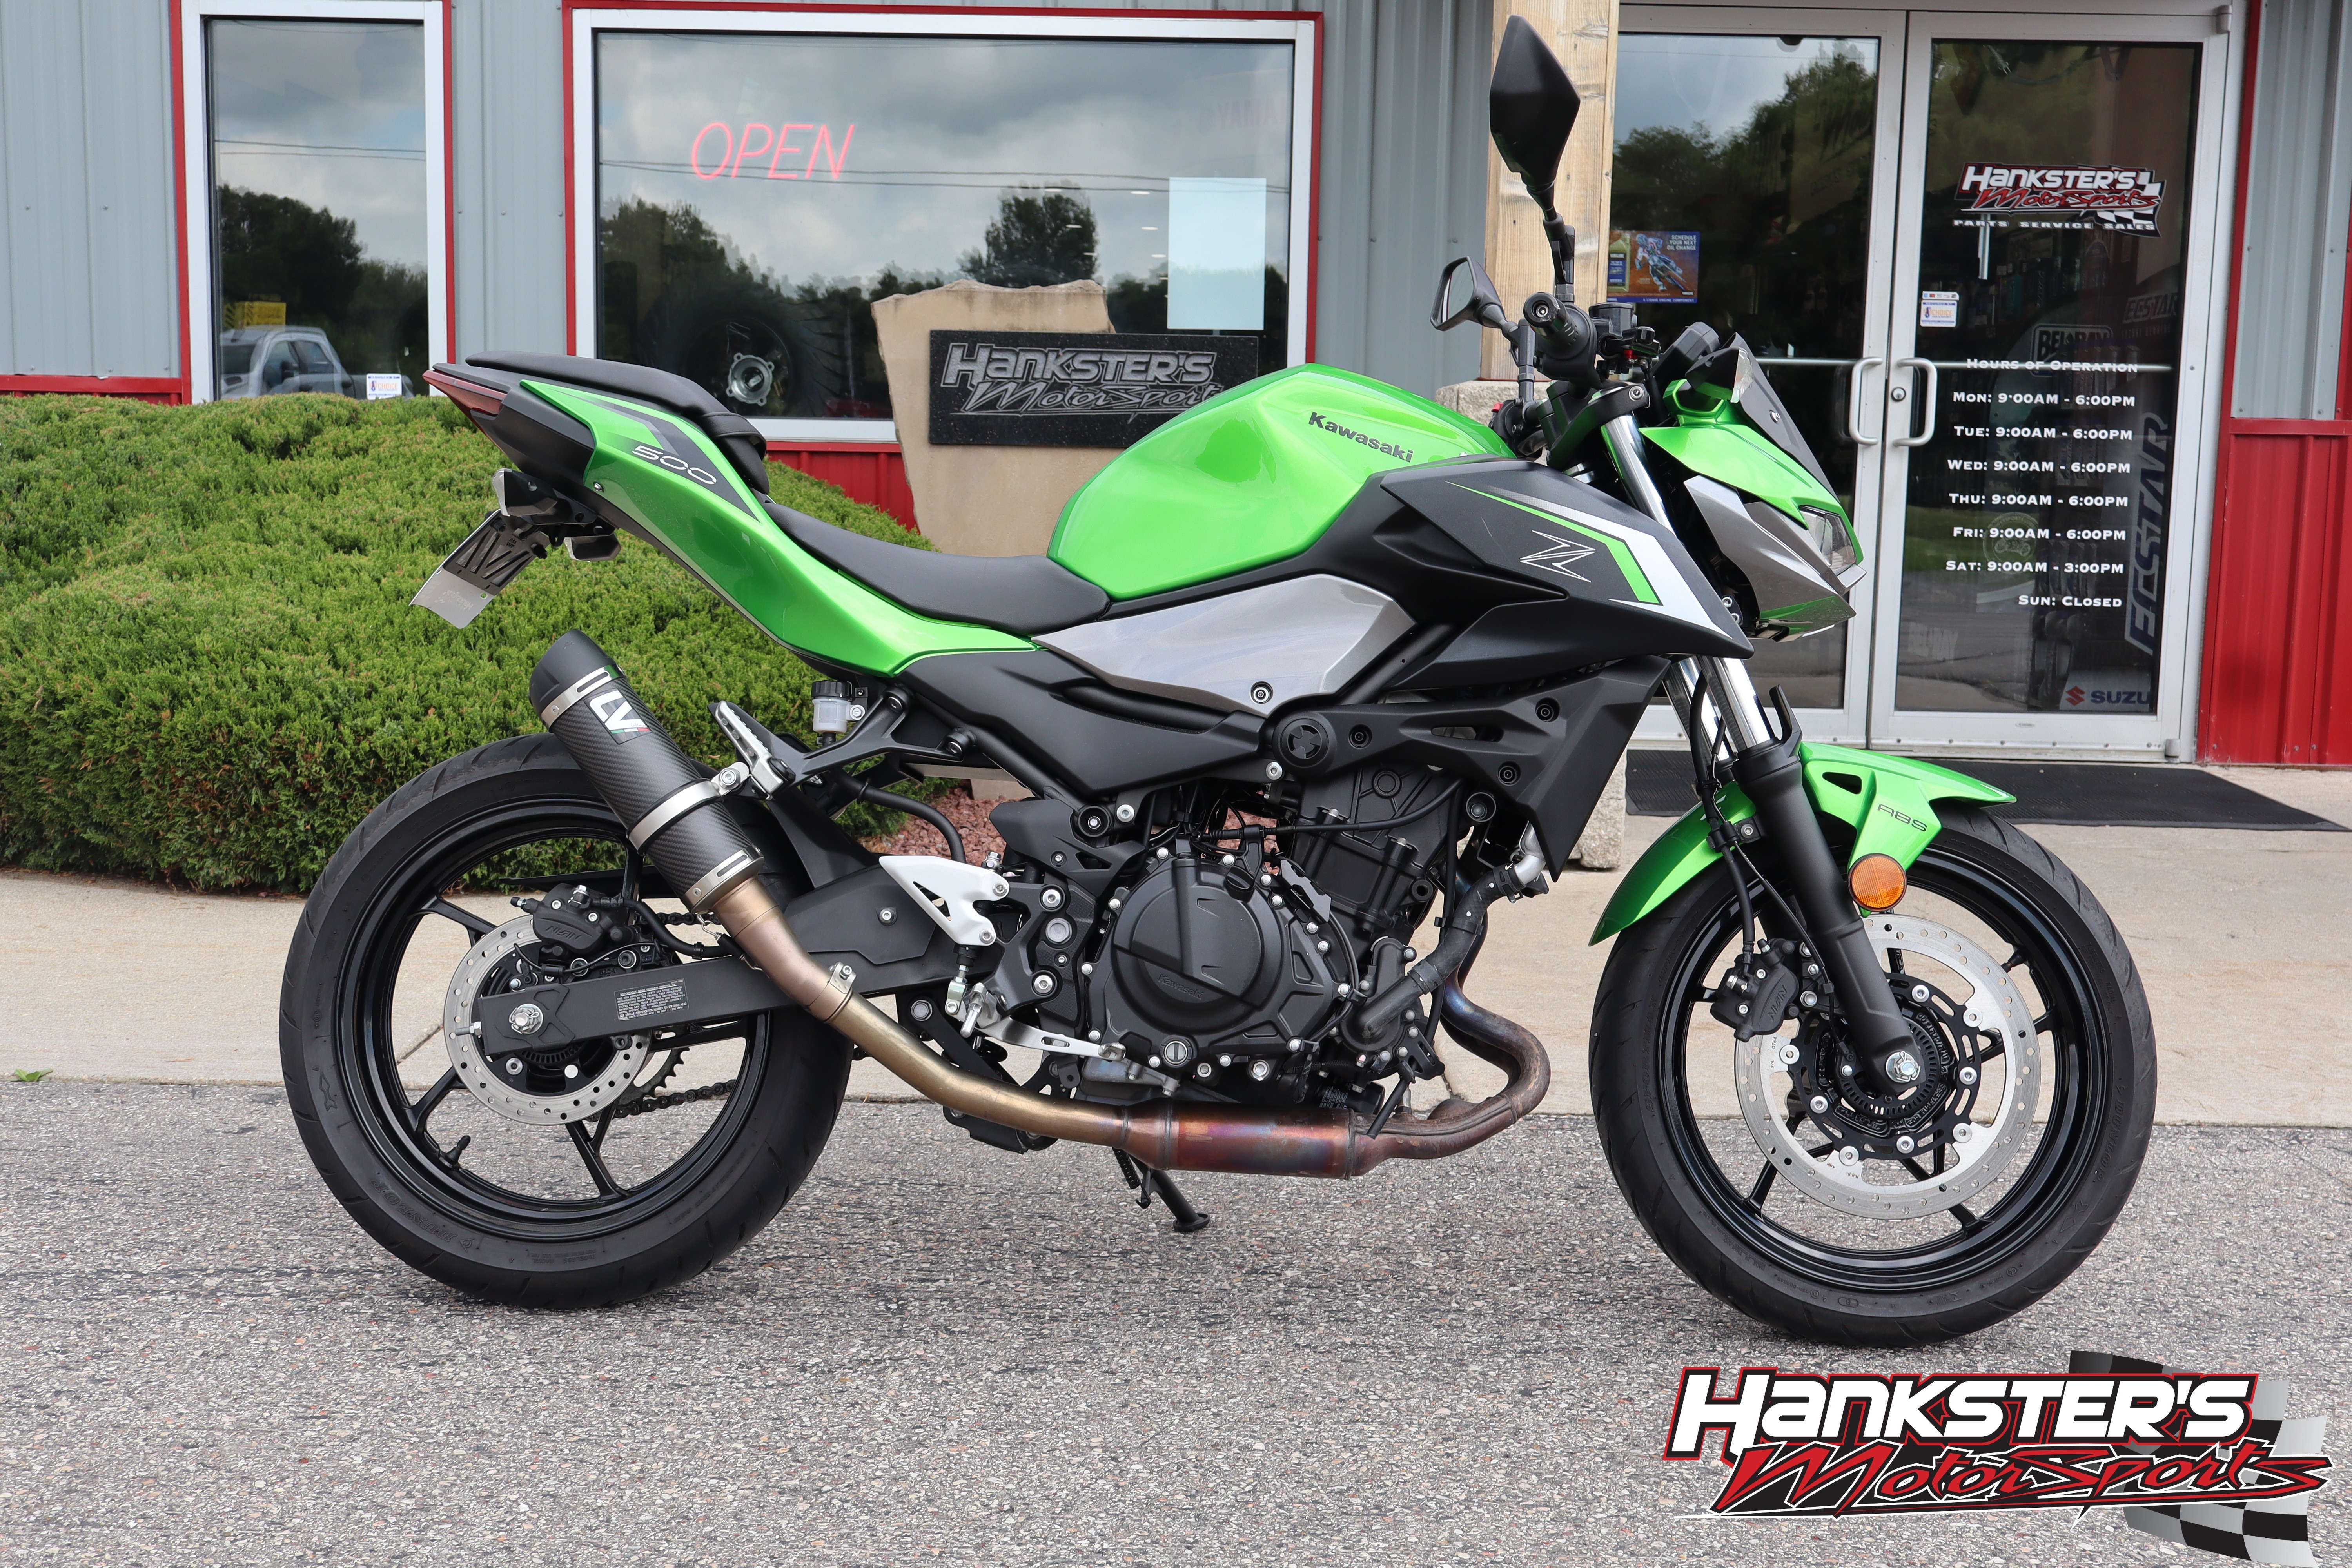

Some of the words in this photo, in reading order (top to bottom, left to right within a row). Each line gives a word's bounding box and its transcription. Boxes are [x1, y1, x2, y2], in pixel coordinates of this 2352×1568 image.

[691, 122, 855, 180] OPEN
[2019, 221, 2094, 229] SERVICE
[2103, 223, 2156, 231] SALES
[1966, 358, 2019, 370] HOURS
[2025, 361, 2042, 370] OF
[2050, 360, 2138, 373] OPERATION
[1953, 391, 1992, 403] MON:
[2075, 394, 2135, 407] 6:00PM
[1308, 412, 1414, 462] Kawasaki
[1953, 425, 1990, 437] TUE:
[1996, 426, 2056, 439] 9:00AM
[2073, 428, 2132, 441] 6:00PM
[632, 445, 717, 485] 500
[1947, 459, 1988, 471] WED:
[1993, 460, 2054, 472] 9:00AM
[2071, 462, 2131, 474] 6:00PM
[1948, 493, 1985, 504] THU:
[1991, 494, 2052, 506] 9:00AM
[2068, 495, 2128, 507] 6:00PM
[1953, 526, 1984, 538] FRI:
[1989, 527, 2049, 539] 9:00AM
[2066, 529, 2126, 541] 6:00PM
[2129, 414, 2168, 654] ECSTAR
[1945, 560, 1982, 572] SAT:
[1987, 561, 2047, 572] 9:00AM
[2063, 562, 2123, 574] 3:00PM
[2018, 594, 2056, 606] SUN:
[2062, 595, 2122, 608] CLOSED
[1878, 804, 1927, 832] ABS
[1157, 973, 1205, 1000] Kawasaki
[2093, 1100, 2125, 1180] DUNLOP
[370, 1180, 458, 1242] DUNLOP
